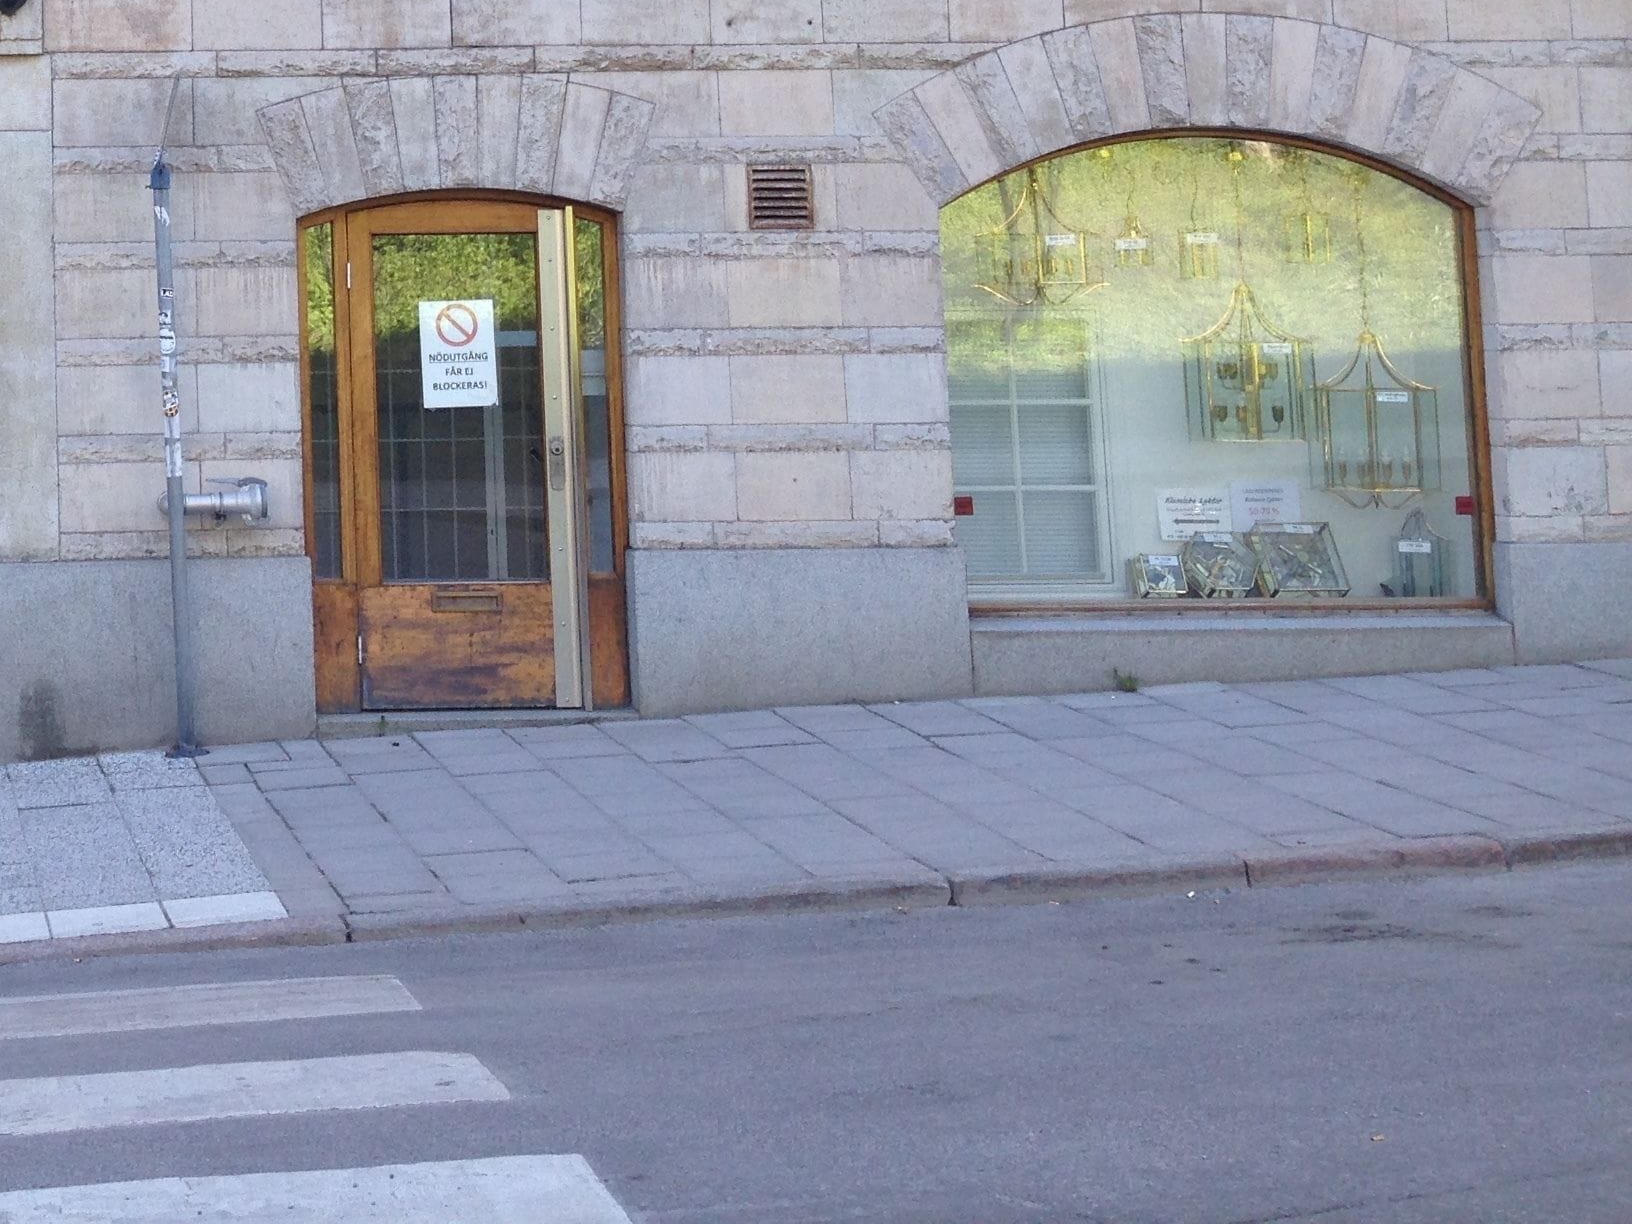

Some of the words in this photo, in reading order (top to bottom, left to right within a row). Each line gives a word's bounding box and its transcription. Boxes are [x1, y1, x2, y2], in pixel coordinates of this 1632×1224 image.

[428, 351, 489, 363] NÖDUTGÅNG
[445, 366, 463, 376] FÅR
[465, 367, 474, 376] EJ
[432, 380, 488, 391] BLOCKERAS!
